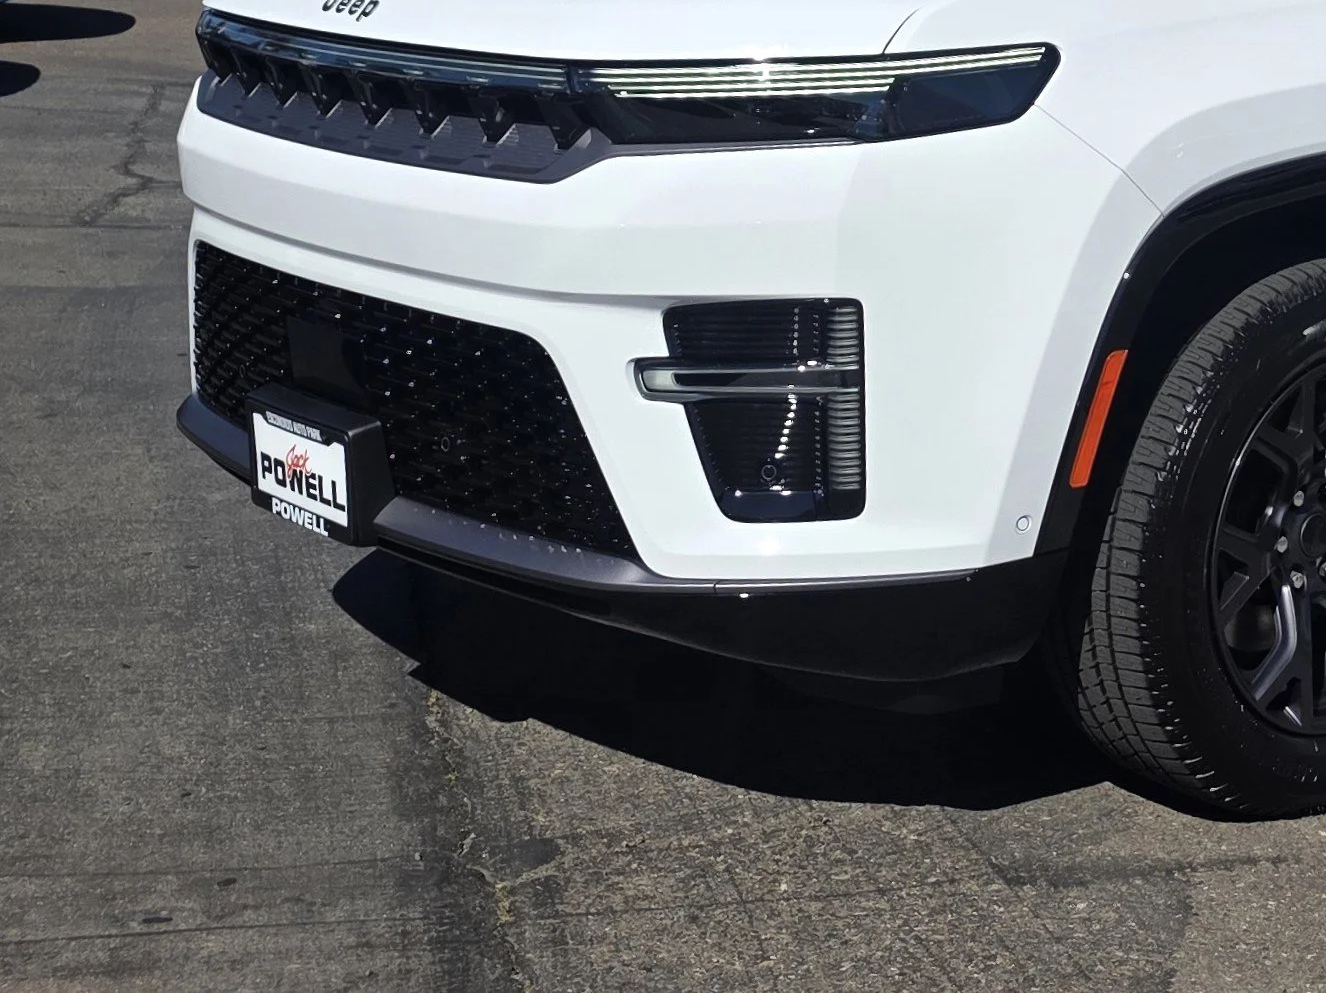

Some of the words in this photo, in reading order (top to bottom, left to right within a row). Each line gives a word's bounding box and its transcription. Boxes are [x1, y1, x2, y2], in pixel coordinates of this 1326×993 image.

[286, 443, 313, 478] Jack
[260, 451, 346, 513] POWELL
[272, 496, 329, 537] POWELL
